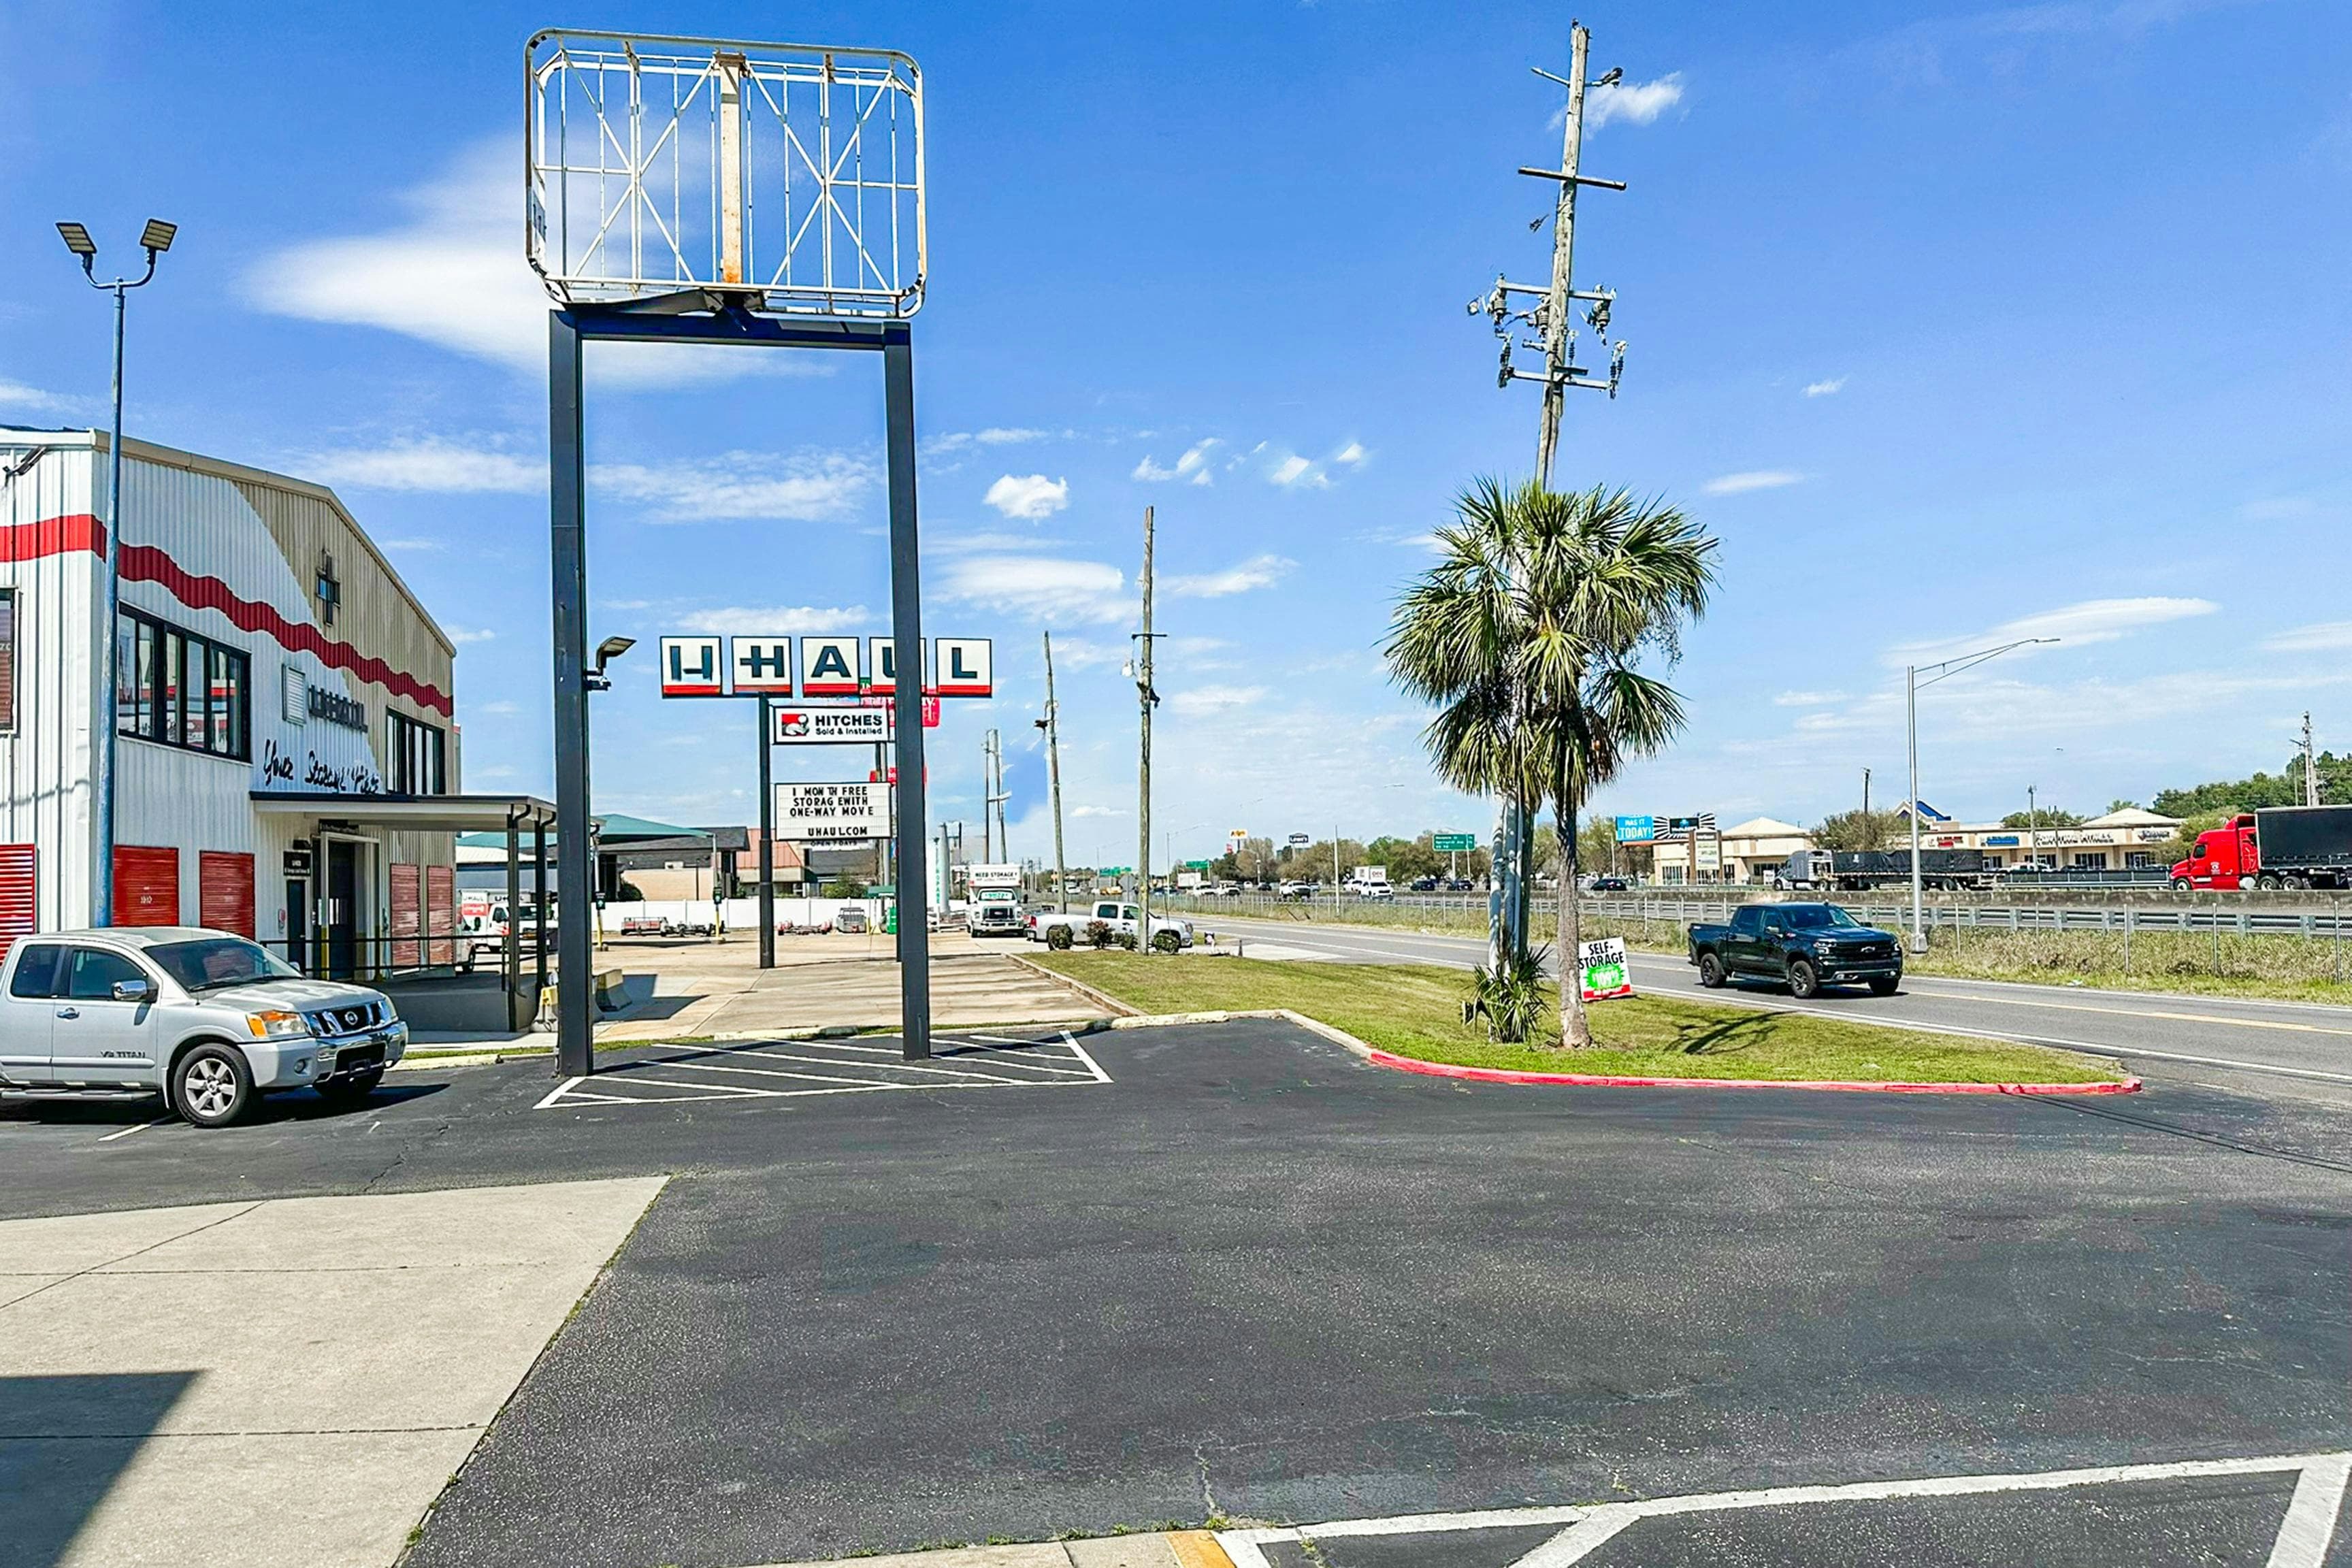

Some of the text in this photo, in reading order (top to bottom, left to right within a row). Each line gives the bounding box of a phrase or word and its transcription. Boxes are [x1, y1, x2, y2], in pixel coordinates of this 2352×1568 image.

[815, 715, 882, 726] HITCHES
[843, 786, 867, 796] FREE
[789, 807, 836, 817] ONE-WAY
[1620, 826, 1651, 838] TODAY!
[1588, 941, 1613, 956] SELF-
[1578, 951, 1624, 970] STORAGE
